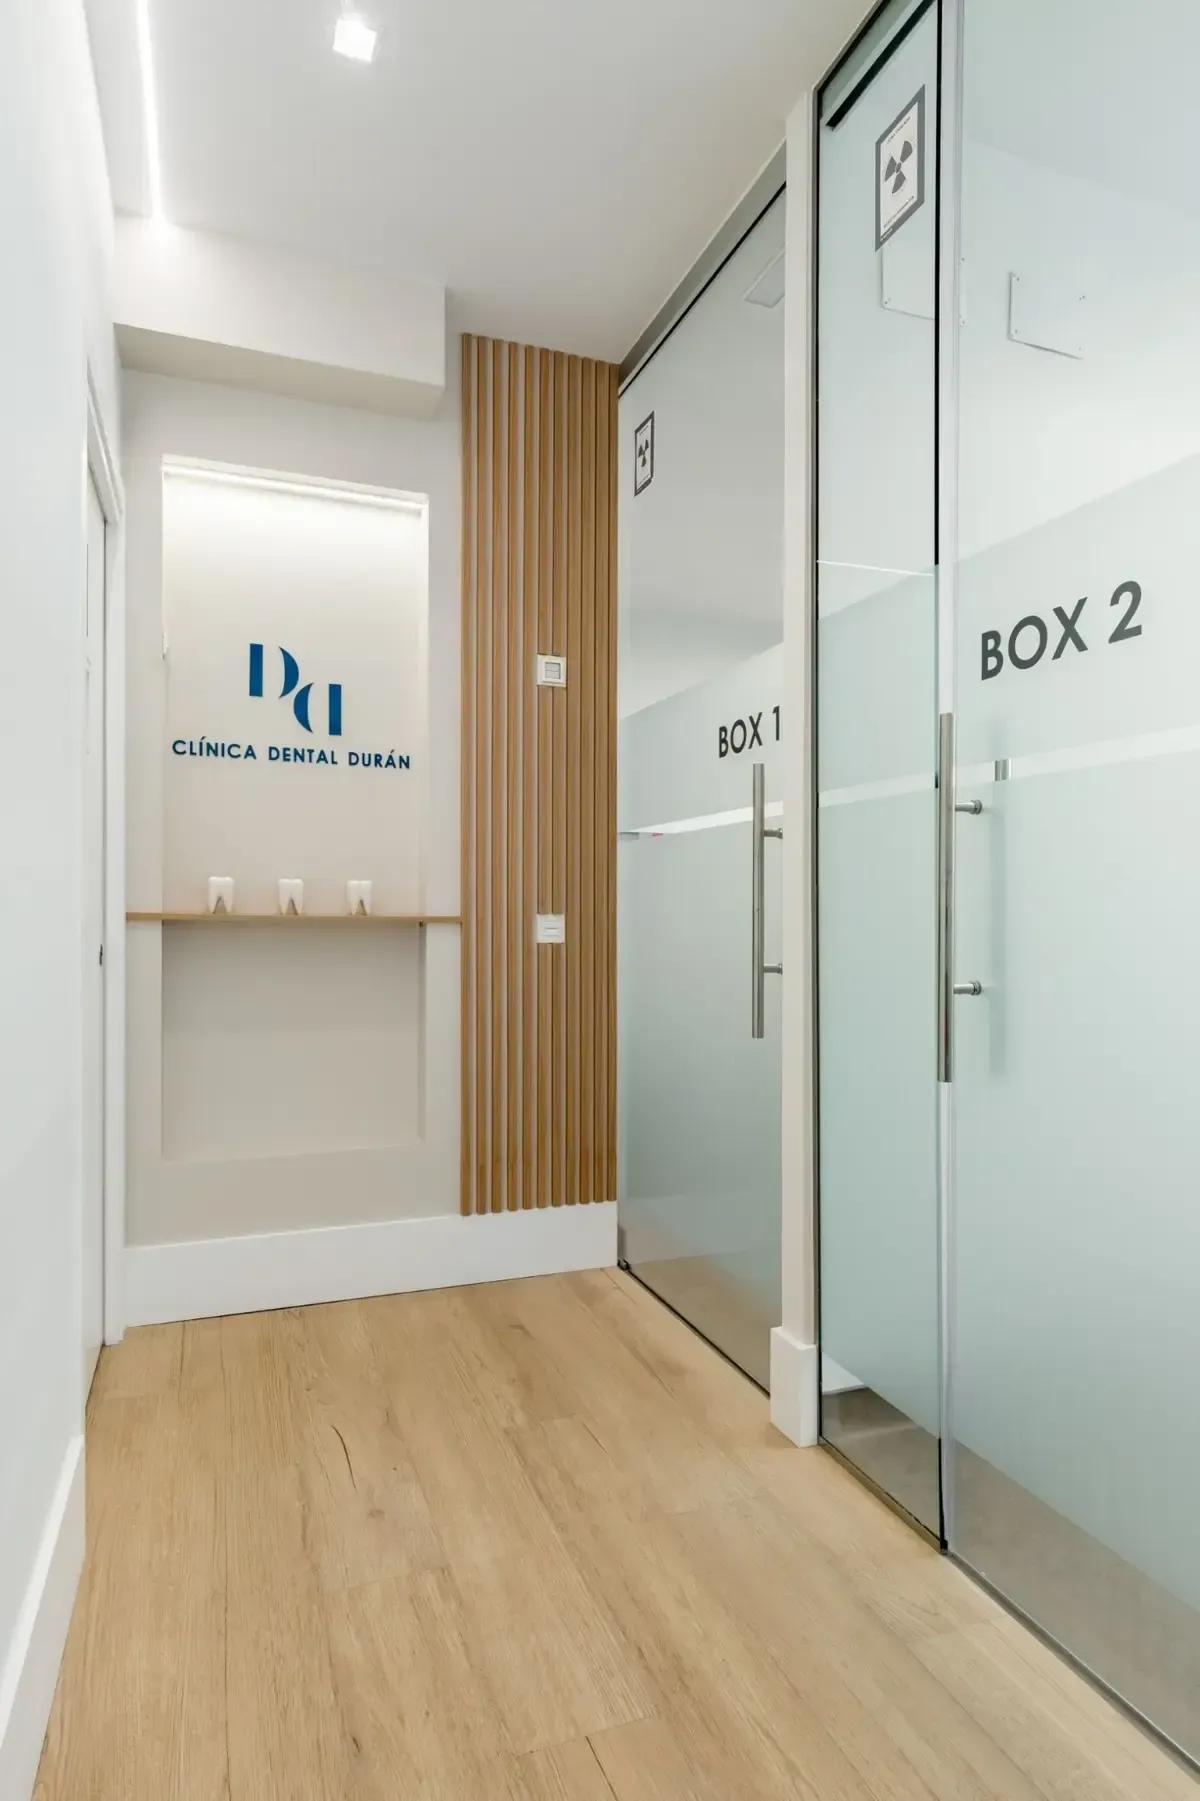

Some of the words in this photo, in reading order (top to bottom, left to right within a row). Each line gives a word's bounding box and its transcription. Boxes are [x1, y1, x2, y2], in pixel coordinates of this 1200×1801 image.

[981, 596, 1089, 681] BOX
[1108, 580, 1142, 645] 2
[172, 736, 257, 760] CLÍNICA
[268, 746, 338, 765] DENTAL
[348, 749, 410, 769] DURÁN
[718, 711, 763, 759] BOX
[772, 705, 780, 741] 1
